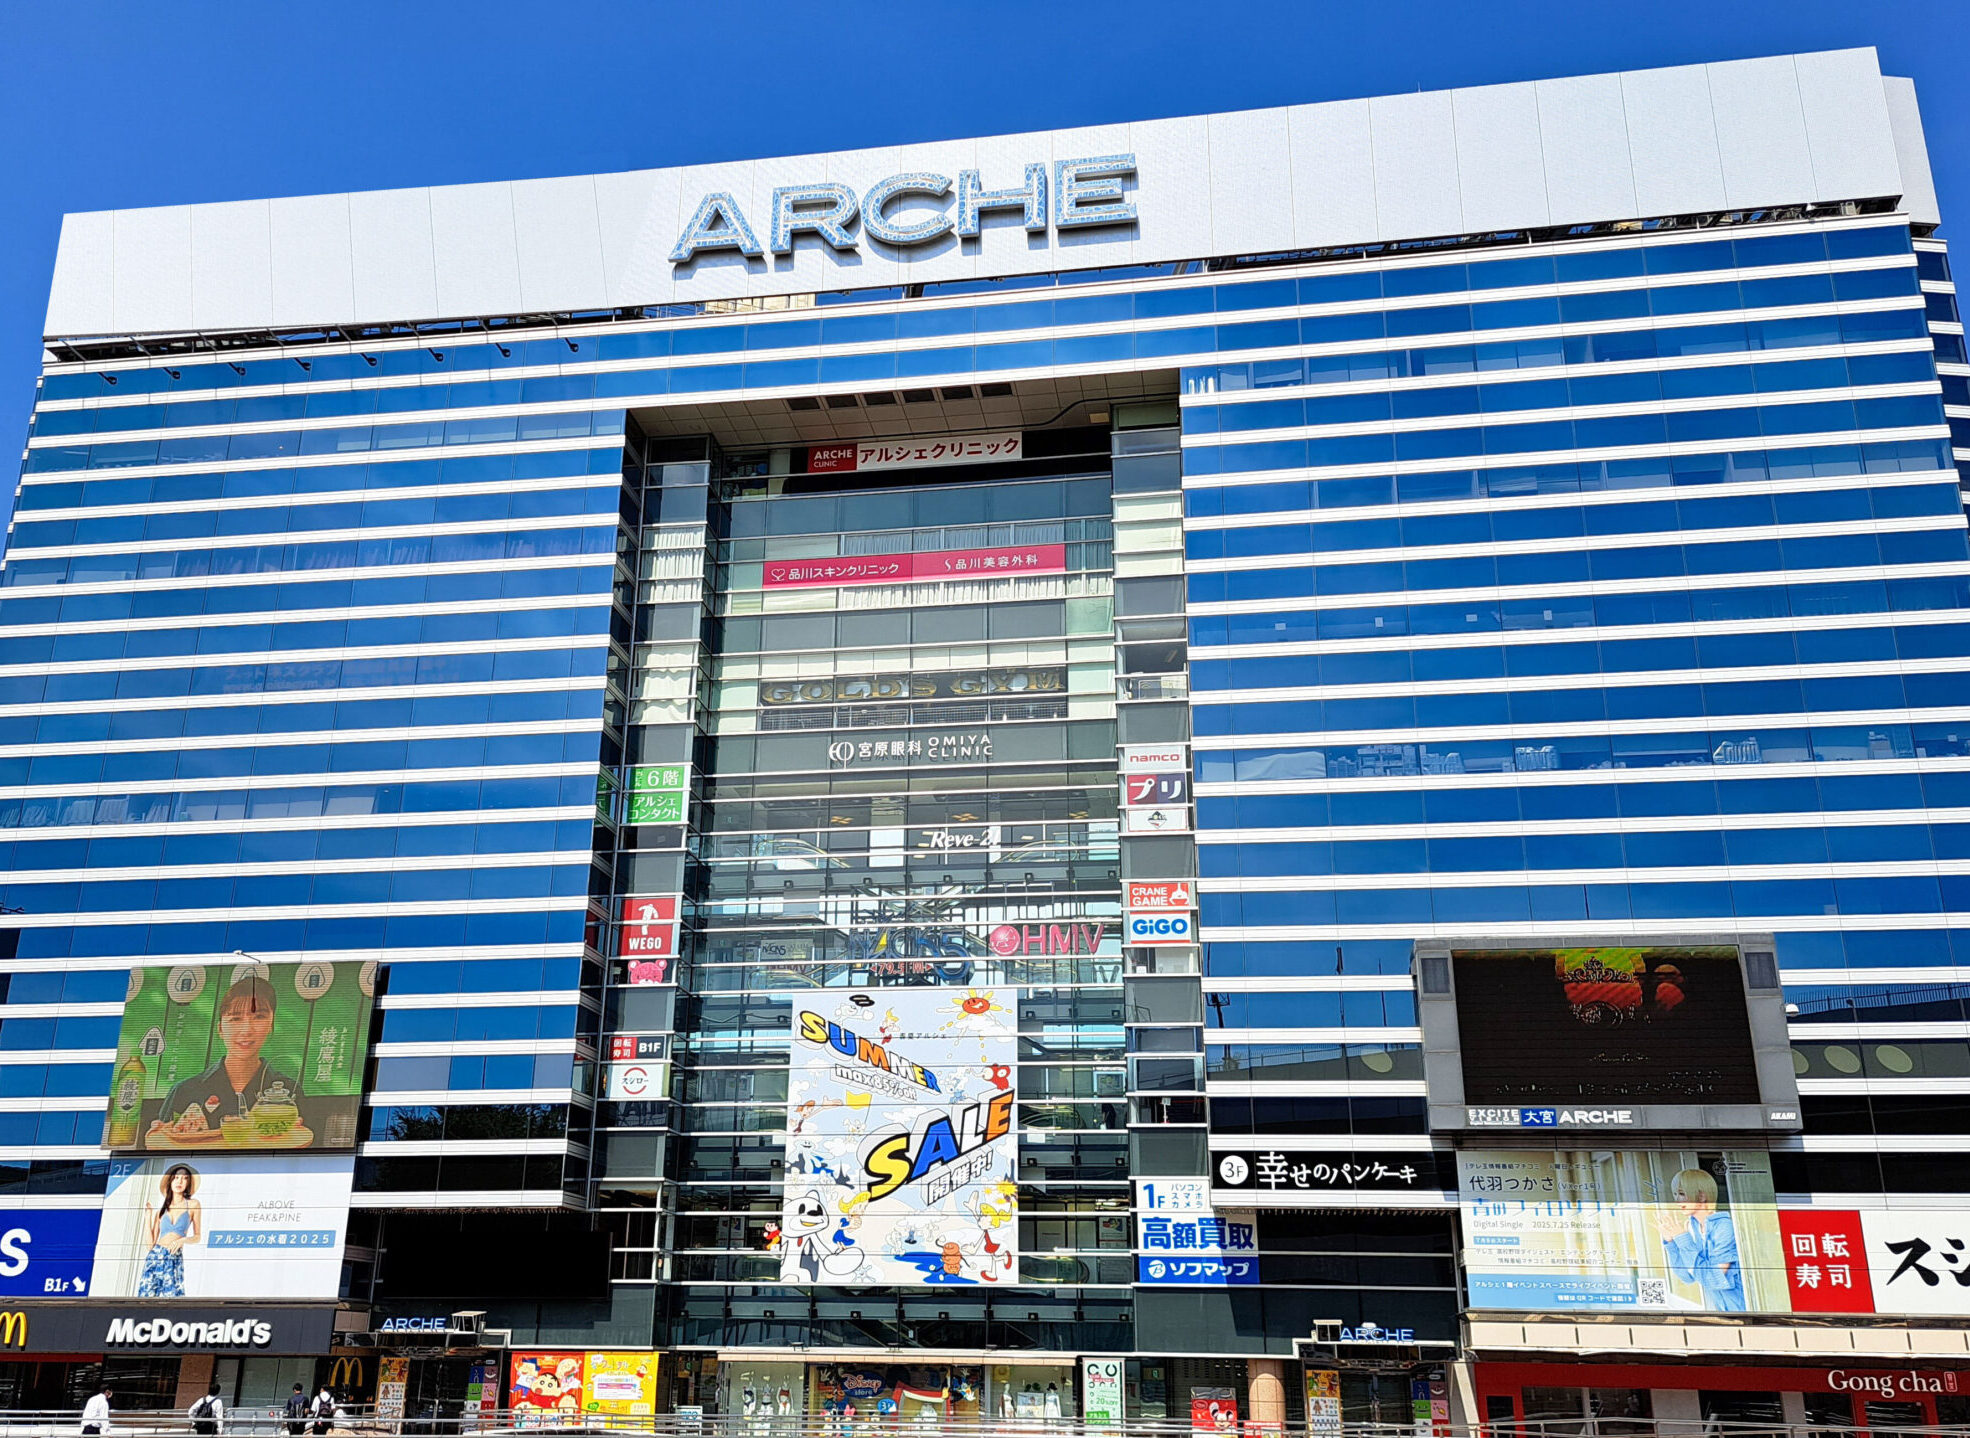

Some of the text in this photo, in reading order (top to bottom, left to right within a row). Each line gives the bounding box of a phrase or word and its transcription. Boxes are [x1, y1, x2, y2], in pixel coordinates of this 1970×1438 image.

[668, 152, 1138, 263] ARCHE
[814, 449, 853, 460] ARCHE
[860, 438, 1019, 463] アルシェクリニック
[814, 460, 838, 468] CLINIC
[955, 554, 1038, 570] 品川美容外科
[788, 563, 899, 579] 品川スキンクリニック
[762, 671, 1065, 703] GOLD'S GYM
[928, 735, 991, 747] OMIYA
[858, 740, 922, 757] 宮原眼科
[928, 745, 993, 758] CLINIC
[1130, 754, 1180, 763] namco
[648, 770, 679, 786] 6階
[1130, 778, 1182, 800] プリ
[634, 796, 676, 807] アルシェ
[629, 808, 680, 819] コンタクト
[1132, 887, 1168, 896] CRANE
[1132, 896, 1168, 906] GAME
[1132, 918, 1188, 935] GiGO
[628, 937, 662, 950] WEGO
[1022, 924, 1104, 955] HMV
[613, 1039, 632, 1049] 回転
[639, 1041, 662, 1053] B1F
[613, 1049, 631, 1058] 寿司
[799, 1010, 942, 1094] SUMMER
[622, 1076, 649, 1085] スシロー
[1469, 1109, 1520, 1117] EXCITE
[1524, 1110, 1554, 1124] 大宮
[1558, 1111, 1633, 1124] ARCHE
[864, 1089, 1015, 1202] SALE
[112, 1164, 131, 1178] 2F
[1225, 1162, 1244, 1177] 3F
[1257, 1151, 1418, 1190] 幸せのパンケーキ
[927, 1149, 993, 1206] 開催中!
[1469, 1175, 1553, 1191] 代羽つかさ
[1171, 1183, 1203, 1191] パソコン
[1142, 1184, 1166, 1208] 1F
[1171, 1192, 1203, 1200] スマホ
[257, 1200, 295, 1209] ALBOVE
[247, 1213, 302, 1222] PEAK&PINE
[1473, 1221, 1601, 1229] Digital Single 2025.7.25 Release
[214, 1234, 330, 1245] アルシェの水着2025
[1141, 1217, 1255, 1250] 高額買取
[1791, 1232, 1850, 1258] 回転
[1170, 1262, 1250, 1277] ソフマップ
[1796, 1263, 1852, 1289] 寿司
[44, 1277, 69, 1292] B1F
[381, 1317, 447, 1330] ARCHE
[105, 1318, 272, 1344] McDonald's
[1339, 1328, 1414, 1342] ARCHE
[842, 1373, 882, 1393] Disney
[1827, 1369, 1896, 1398] Gong
[1899, 1371, 1944, 1392] cha
